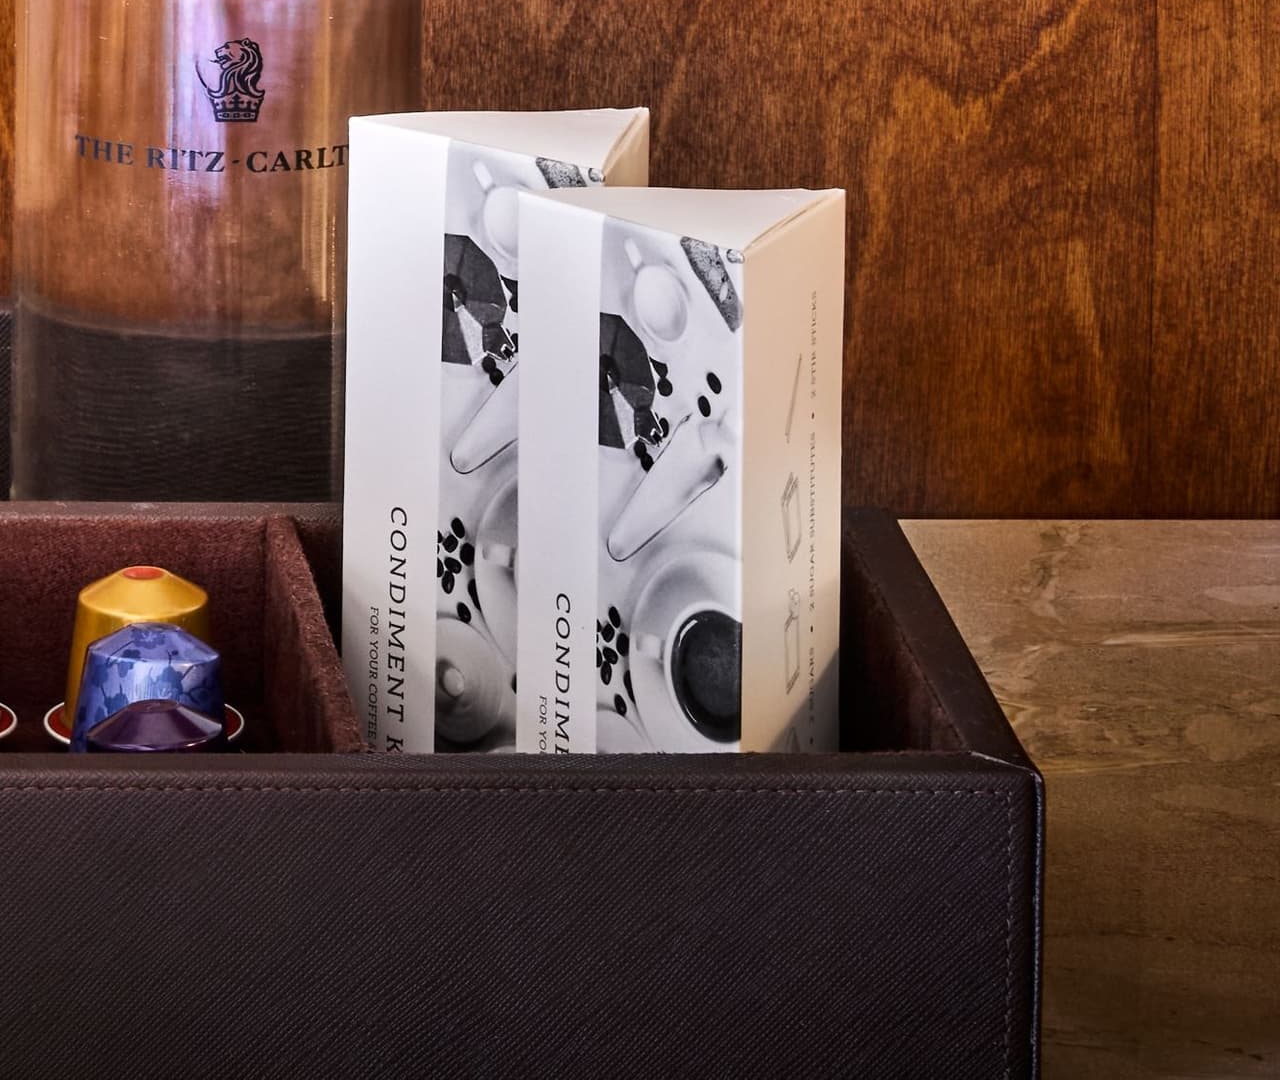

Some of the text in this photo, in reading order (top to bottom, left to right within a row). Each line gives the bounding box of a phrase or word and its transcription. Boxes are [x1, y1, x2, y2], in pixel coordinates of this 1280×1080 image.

[75, 135, 350, 173] THE RITZ-CARLT
[370, 606, 379, 636] FOR
[386, 506, 408, 754] CONDIMENT K
[369, 640, 379, 681] YOUR
[555, 593, 571, 754] CONDIME
[367, 683, 378, 740] COFFEE
[539, 695, 548, 754] FOR YO
